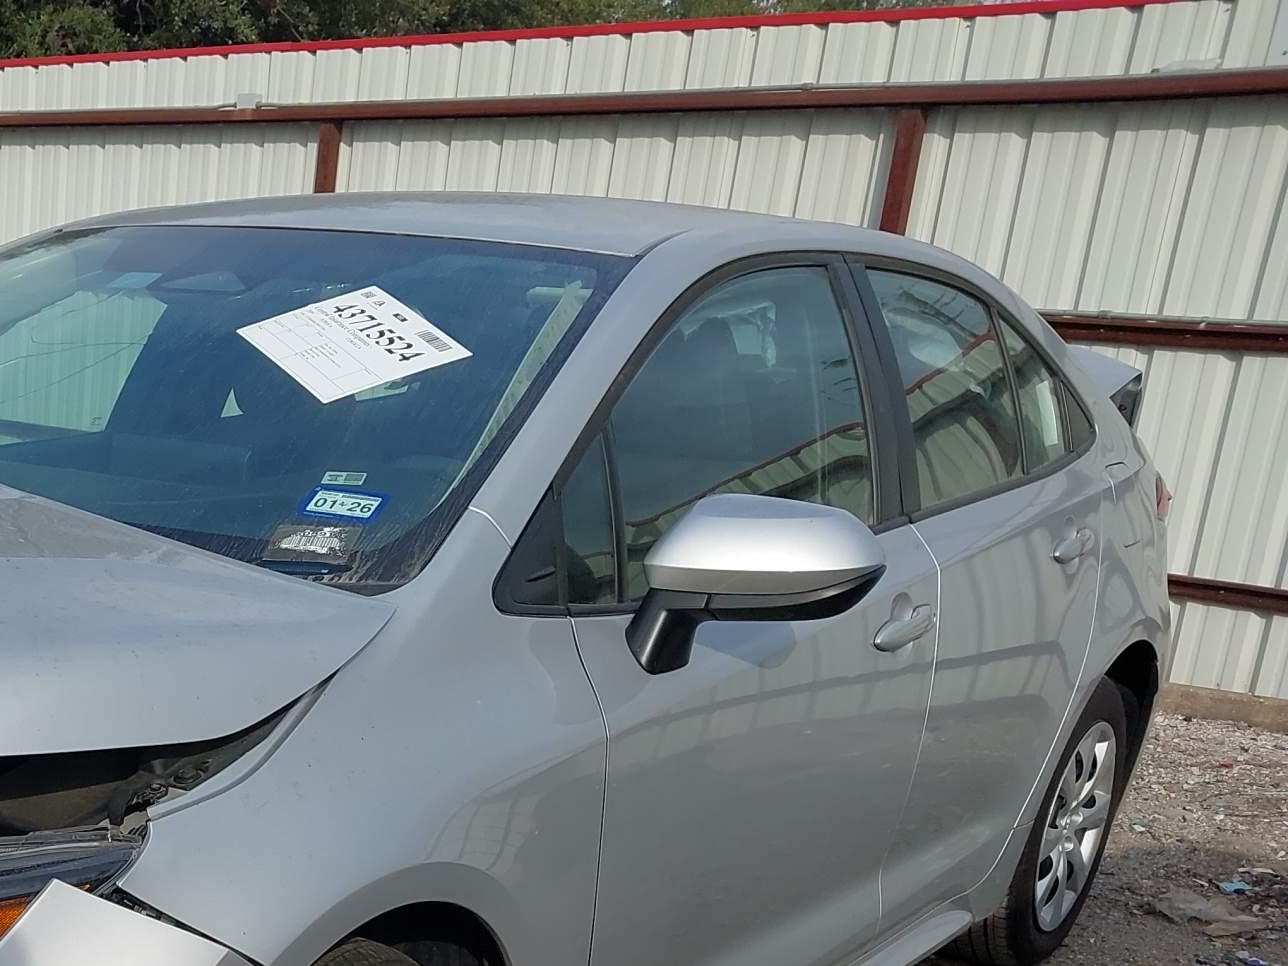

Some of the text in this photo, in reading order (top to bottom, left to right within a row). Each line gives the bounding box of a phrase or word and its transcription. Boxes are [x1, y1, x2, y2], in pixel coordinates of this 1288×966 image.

[333, 304, 425, 362] 43715524
[314, 498, 337, 509] 01
[346, 502, 373, 513] 26
